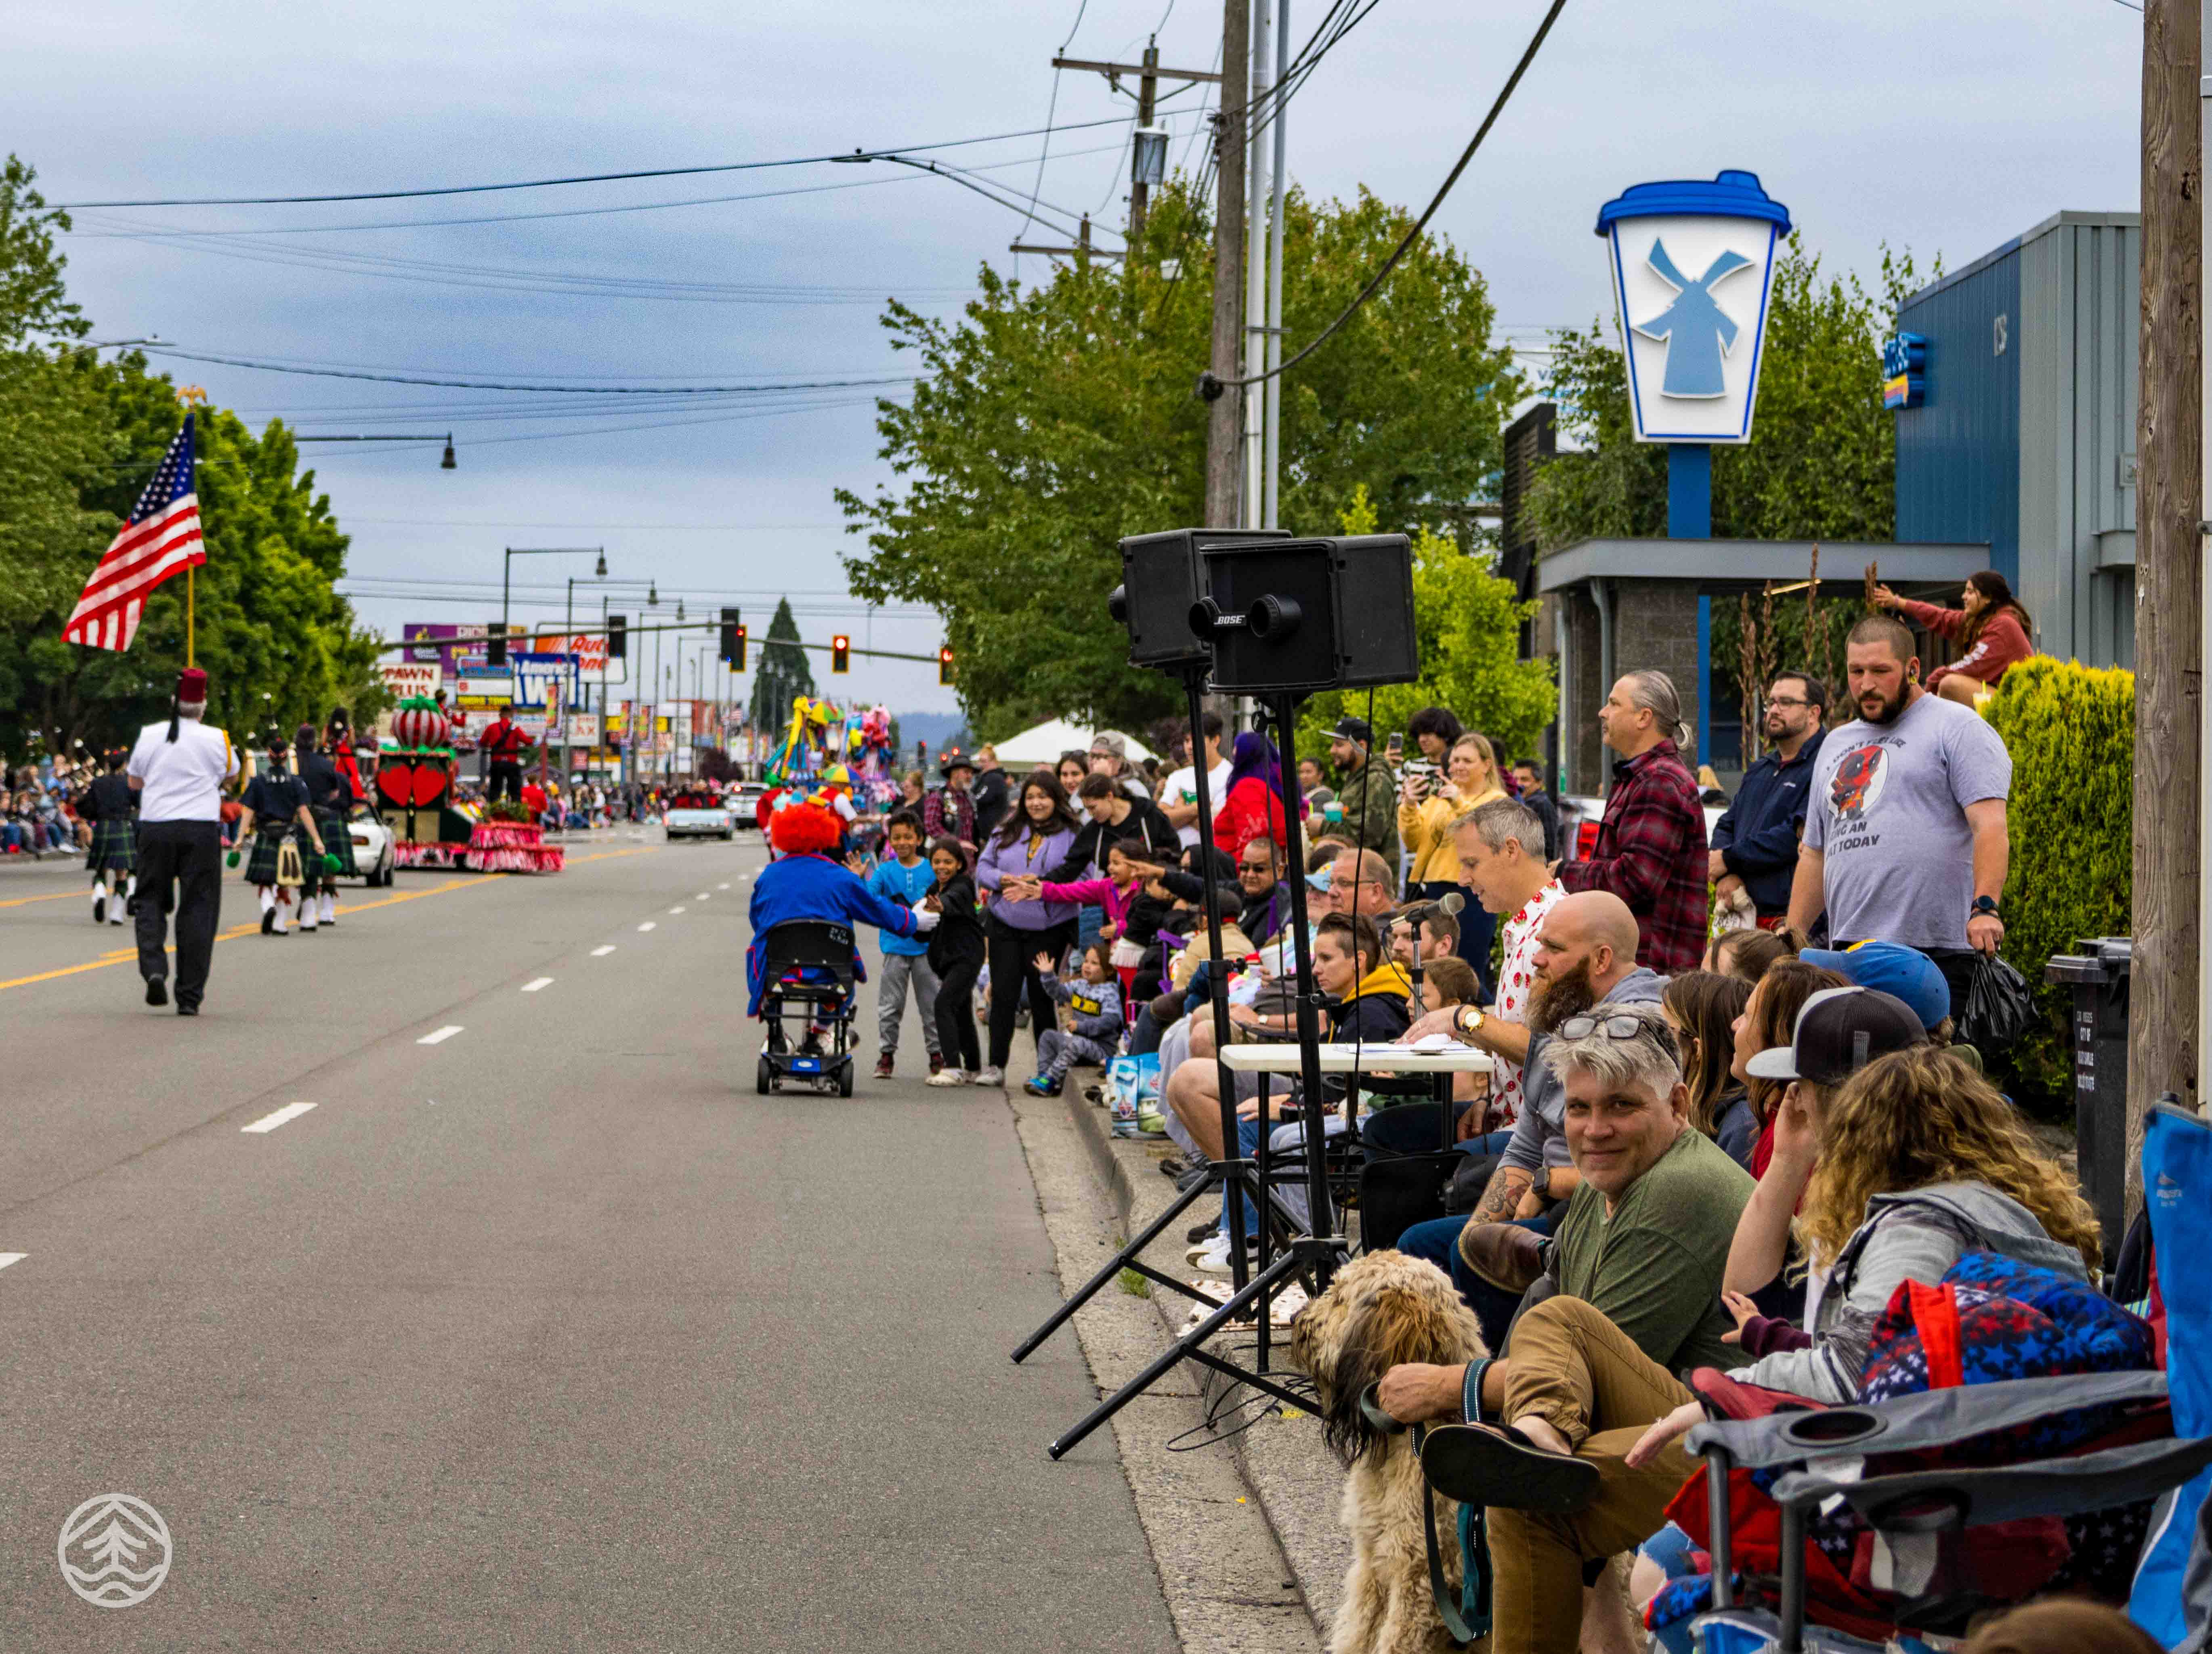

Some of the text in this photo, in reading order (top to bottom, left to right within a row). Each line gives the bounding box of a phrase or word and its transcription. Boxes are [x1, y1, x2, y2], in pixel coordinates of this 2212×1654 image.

[1214, 615, 1245, 625] BOSE
[384, 668, 433, 680] PAWN
[1833, 741, 1864, 763] DON'T
[1849, 821, 1867, 833] AN
[1838, 834, 1880, 853] TODAY
